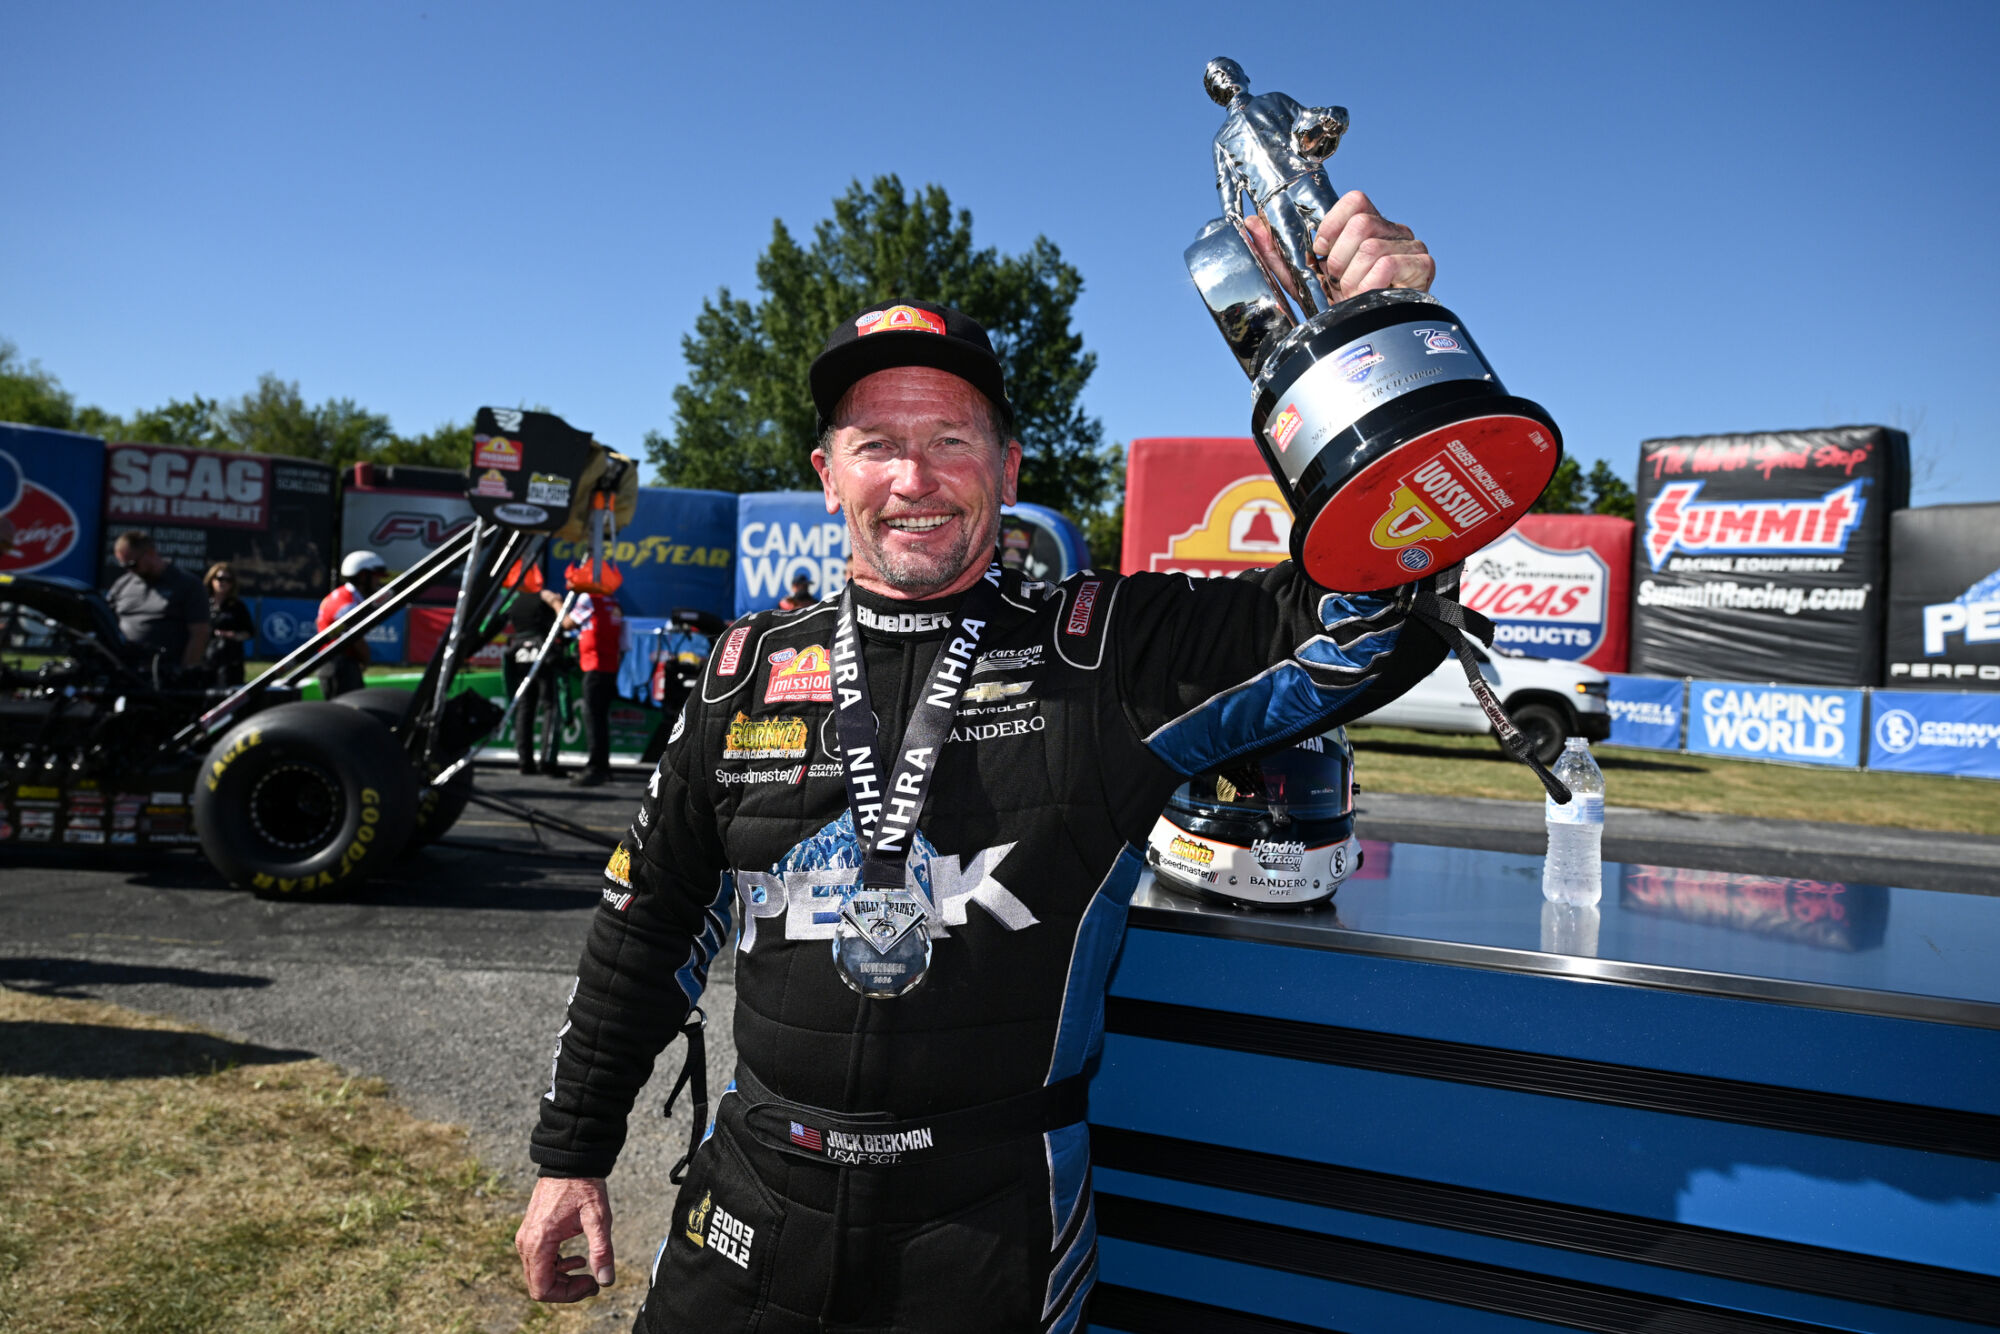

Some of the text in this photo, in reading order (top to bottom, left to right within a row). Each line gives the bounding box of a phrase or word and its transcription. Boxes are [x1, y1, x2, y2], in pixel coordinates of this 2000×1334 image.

[1385, 366, 1444, 391] CHAMPION
[110, 449, 264, 503] SCAG
[1446, 439, 1515, 509] DRAG RACING SERIES
[1813, 445, 1868, 476] Shop
[109, 497, 263, 524] POWER EQUIPMENT
[741, 522, 852, 557] CAMPI
[1402, 548, 1430, 570] NHRA
[1669, 558, 1845, 572] RACING EQUIPMENT
[741, 556, 847, 599] WOR
[1069, 581, 1101, 634] SIMPSON
[1638, 579, 1867, 614] SummitRacing.com
[719, 626, 748, 674] SIMPSON
[1494, 625, 1593, 647] ODUCTS
[833, 612, 863, 711] NHRA
[925, 617, 987, 710] NHRA
[955, 700, 1037, 717] HEVROLET
[1474, 685, 1511, 734] SIMPSON
[1702, 689, 1846, 725] CAMPING
[947, 716, 1046, 743] ANDERO
[1702, 714, 1845, 757] WORLD
[205, 731, 263, 792] EAGLE
[715, 766, 793, 788] Speedmaster
[810, 763, 844, 772] CORN
[876, 747, 934, 851] NHRA
[252, 787, 381, 892] GOODYEAR
[1171, 840, 1214, 864] BURNYZZ
[1250, 839, 1306, 857] Hendrick
[1160, 855, 1210, 879] Speedmaster
[1259, 853, 1302, 864] Cars.com
[1250, 876, 1307, 888] BANDERO
[853, 900, 880, 916] WALLY
[827, 1127, 934, 1153] JACK BECKMAN
[711, 1204, 755, 1248] 2003
[706, 1225, 751, 1270] 2012
